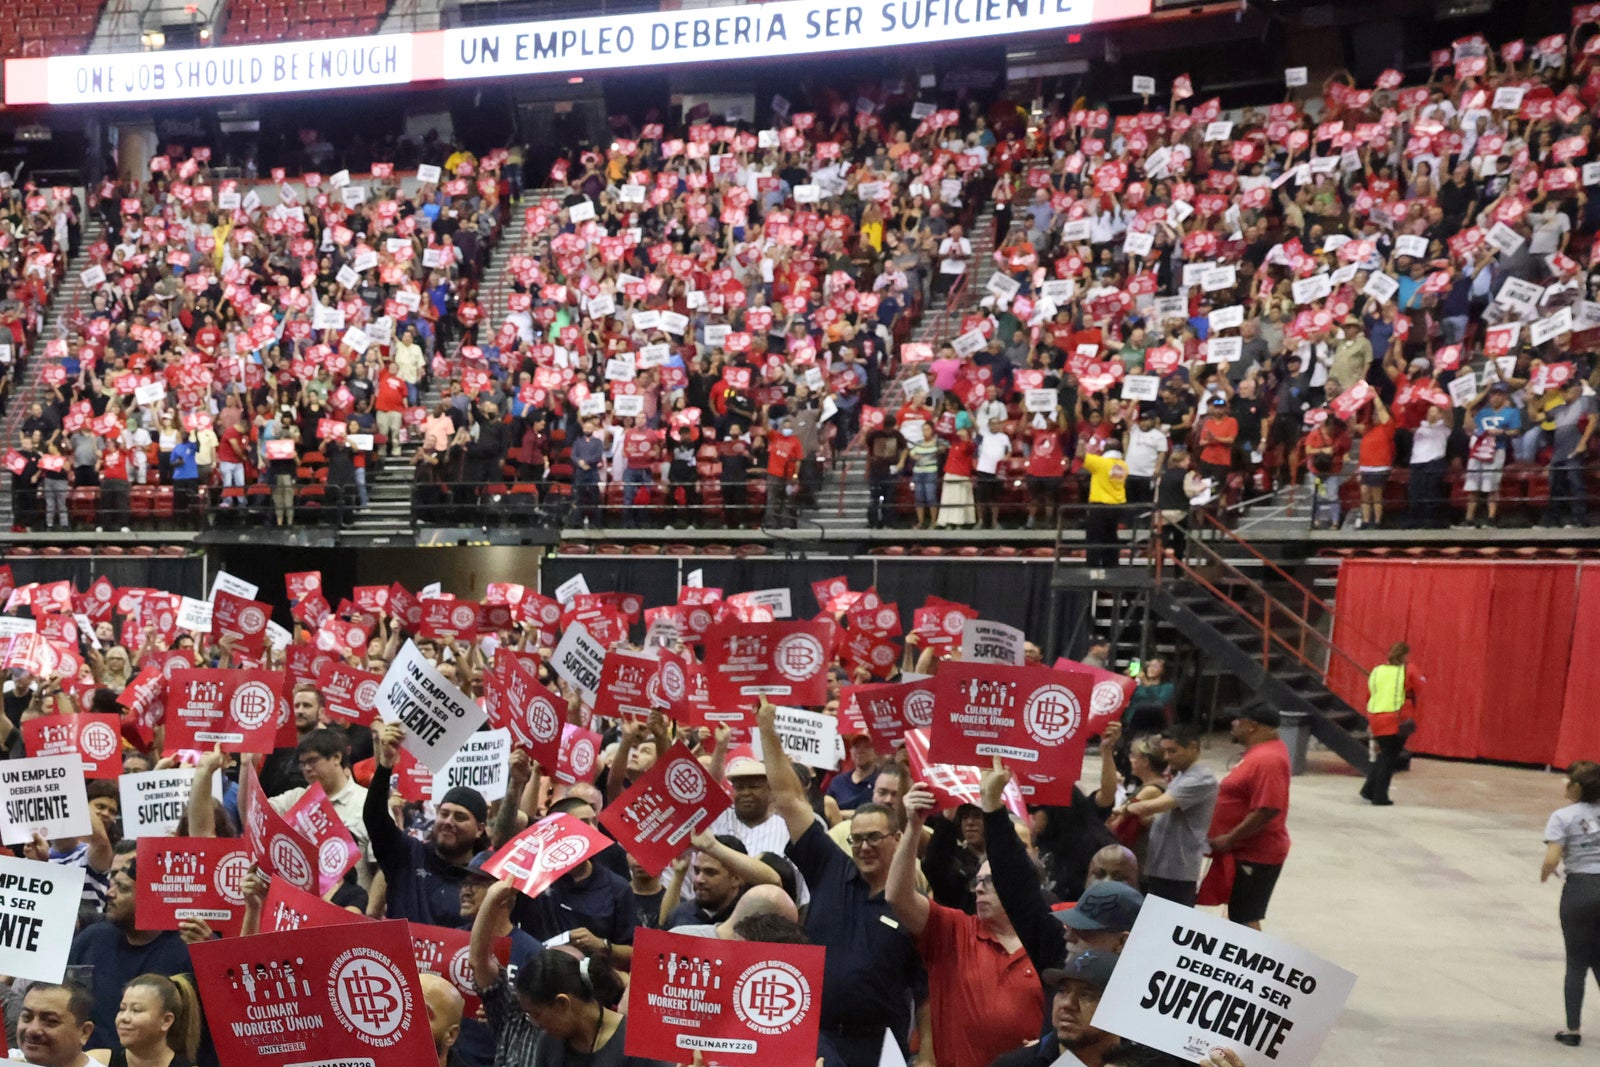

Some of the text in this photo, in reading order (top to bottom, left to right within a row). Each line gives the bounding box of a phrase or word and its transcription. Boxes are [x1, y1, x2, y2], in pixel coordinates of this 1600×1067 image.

[461, 36, 499, 65] UN
[515, 28, 634, 61] EMPLEO
[806, 7, 862, 40] SER
[76, 45, 396, 93] ONE JOB SHOULD BE ENOUGH
[407, 661, 465, 719] UN EMPLEO
[387, 681, 446, 747] SUFICIENTE
[432, 705, 449, 722] SER
[965, 704, 1003, 716] CULINARY
[788, 715, 823, 728] EMPLEO
[950, 713, 1015, 727] WORKERS UNION
[472, 739, 504, 751] EMPLEO
[2, 767, 66, 784] UN EMPLEO
[448, 762, 501, 787] SUFICIENTE
[44, 783, 60, 792] SER
[137, 781, 156, 791] UN
[6, 795, 70, 824] SUFICIENTE
[162, 874, 195, 883] CULINARY
[150, 883, 206, 892] WORKERS UNION
[10, 896, 36, 913] SER
[352, 947, 392, 966] DISPENSERS
[1172, 924, 1317, 996] UN EMPLEO
[1176, 954, 1292, 1010] DEBERÍA SER
[662, 984, 706, 1000] CULINARY
[246, 1001, 300, 1020] CULINARY
[648, 993, 721, 1015] WORKERS UNION
[1140, 970, 1294, 1060] SUFICIENTE
[231, 1014, 324, 1038] WORKERS UNION
[356, 1030, 403, 1045] LAS NV
[679, 1038, 753, 1051] @CULINARY226
